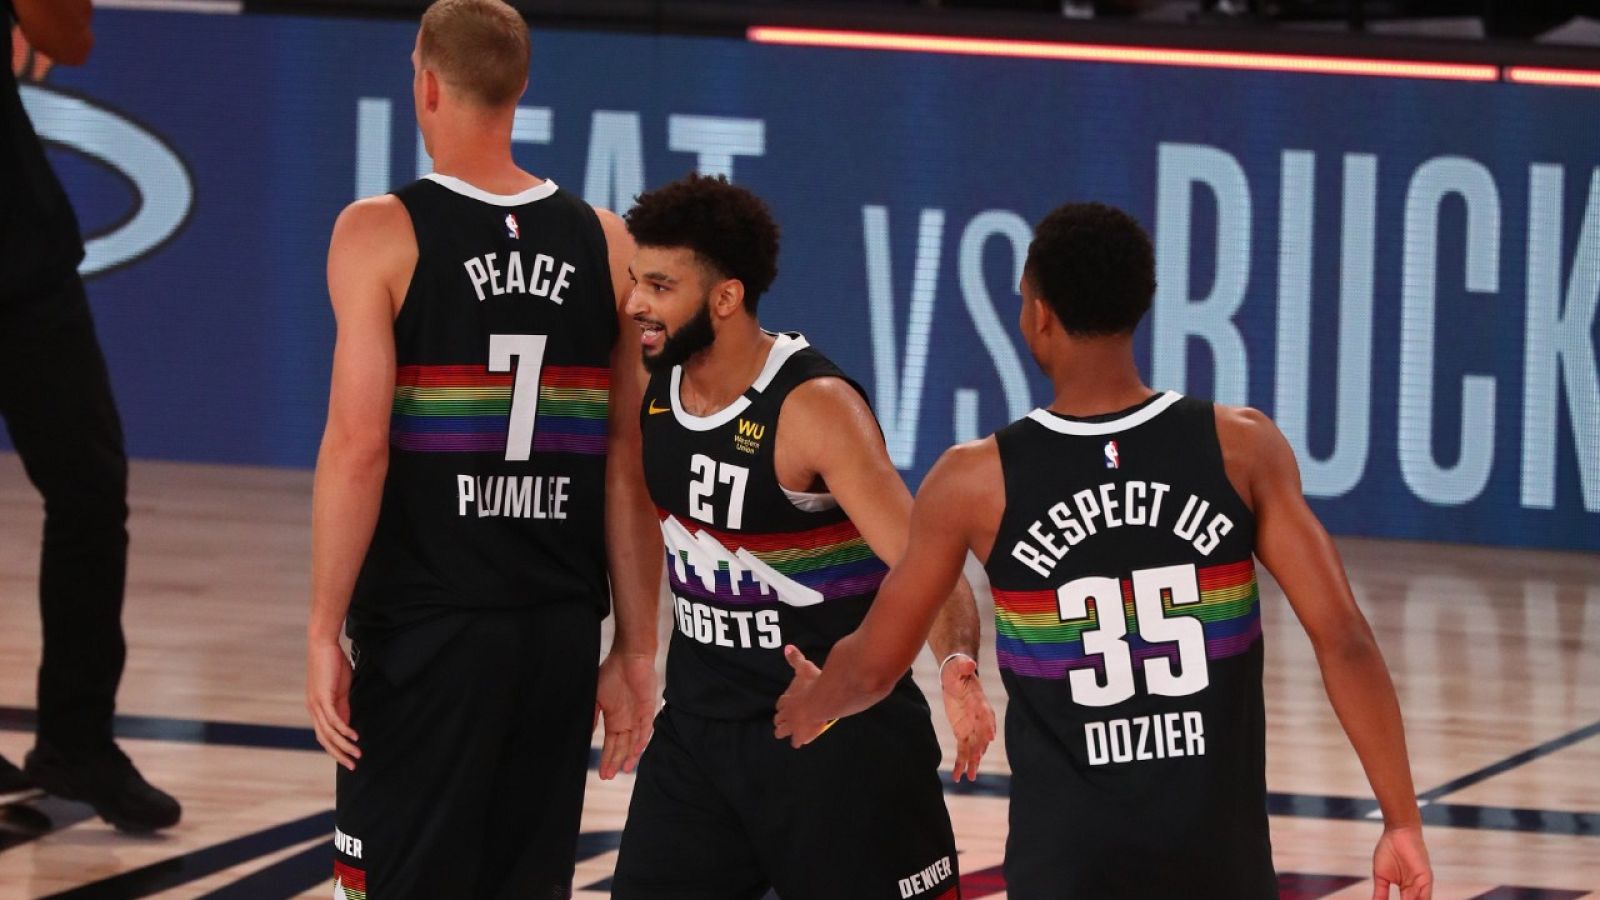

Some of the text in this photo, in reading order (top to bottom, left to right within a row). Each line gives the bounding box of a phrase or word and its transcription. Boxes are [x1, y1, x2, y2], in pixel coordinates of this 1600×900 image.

[464, 251, 576, 305] PEACE
[1151, 142, 1600, 513] BUCK
[488, 334, 548, 461] 7
[739, 418, 765, 440] WU
[457, 474, 571, 519] PLUMLEE
[689, 453, 749, 530] 27
[1011, 480, 1234, 578] RESPECT US
[672, 592, 782, 649] GGETS
[1056, 563, 1209, 707] 35
[1084, 711, 1206, 765] DOZIER
[898, 855, 953, 899] DENVER
